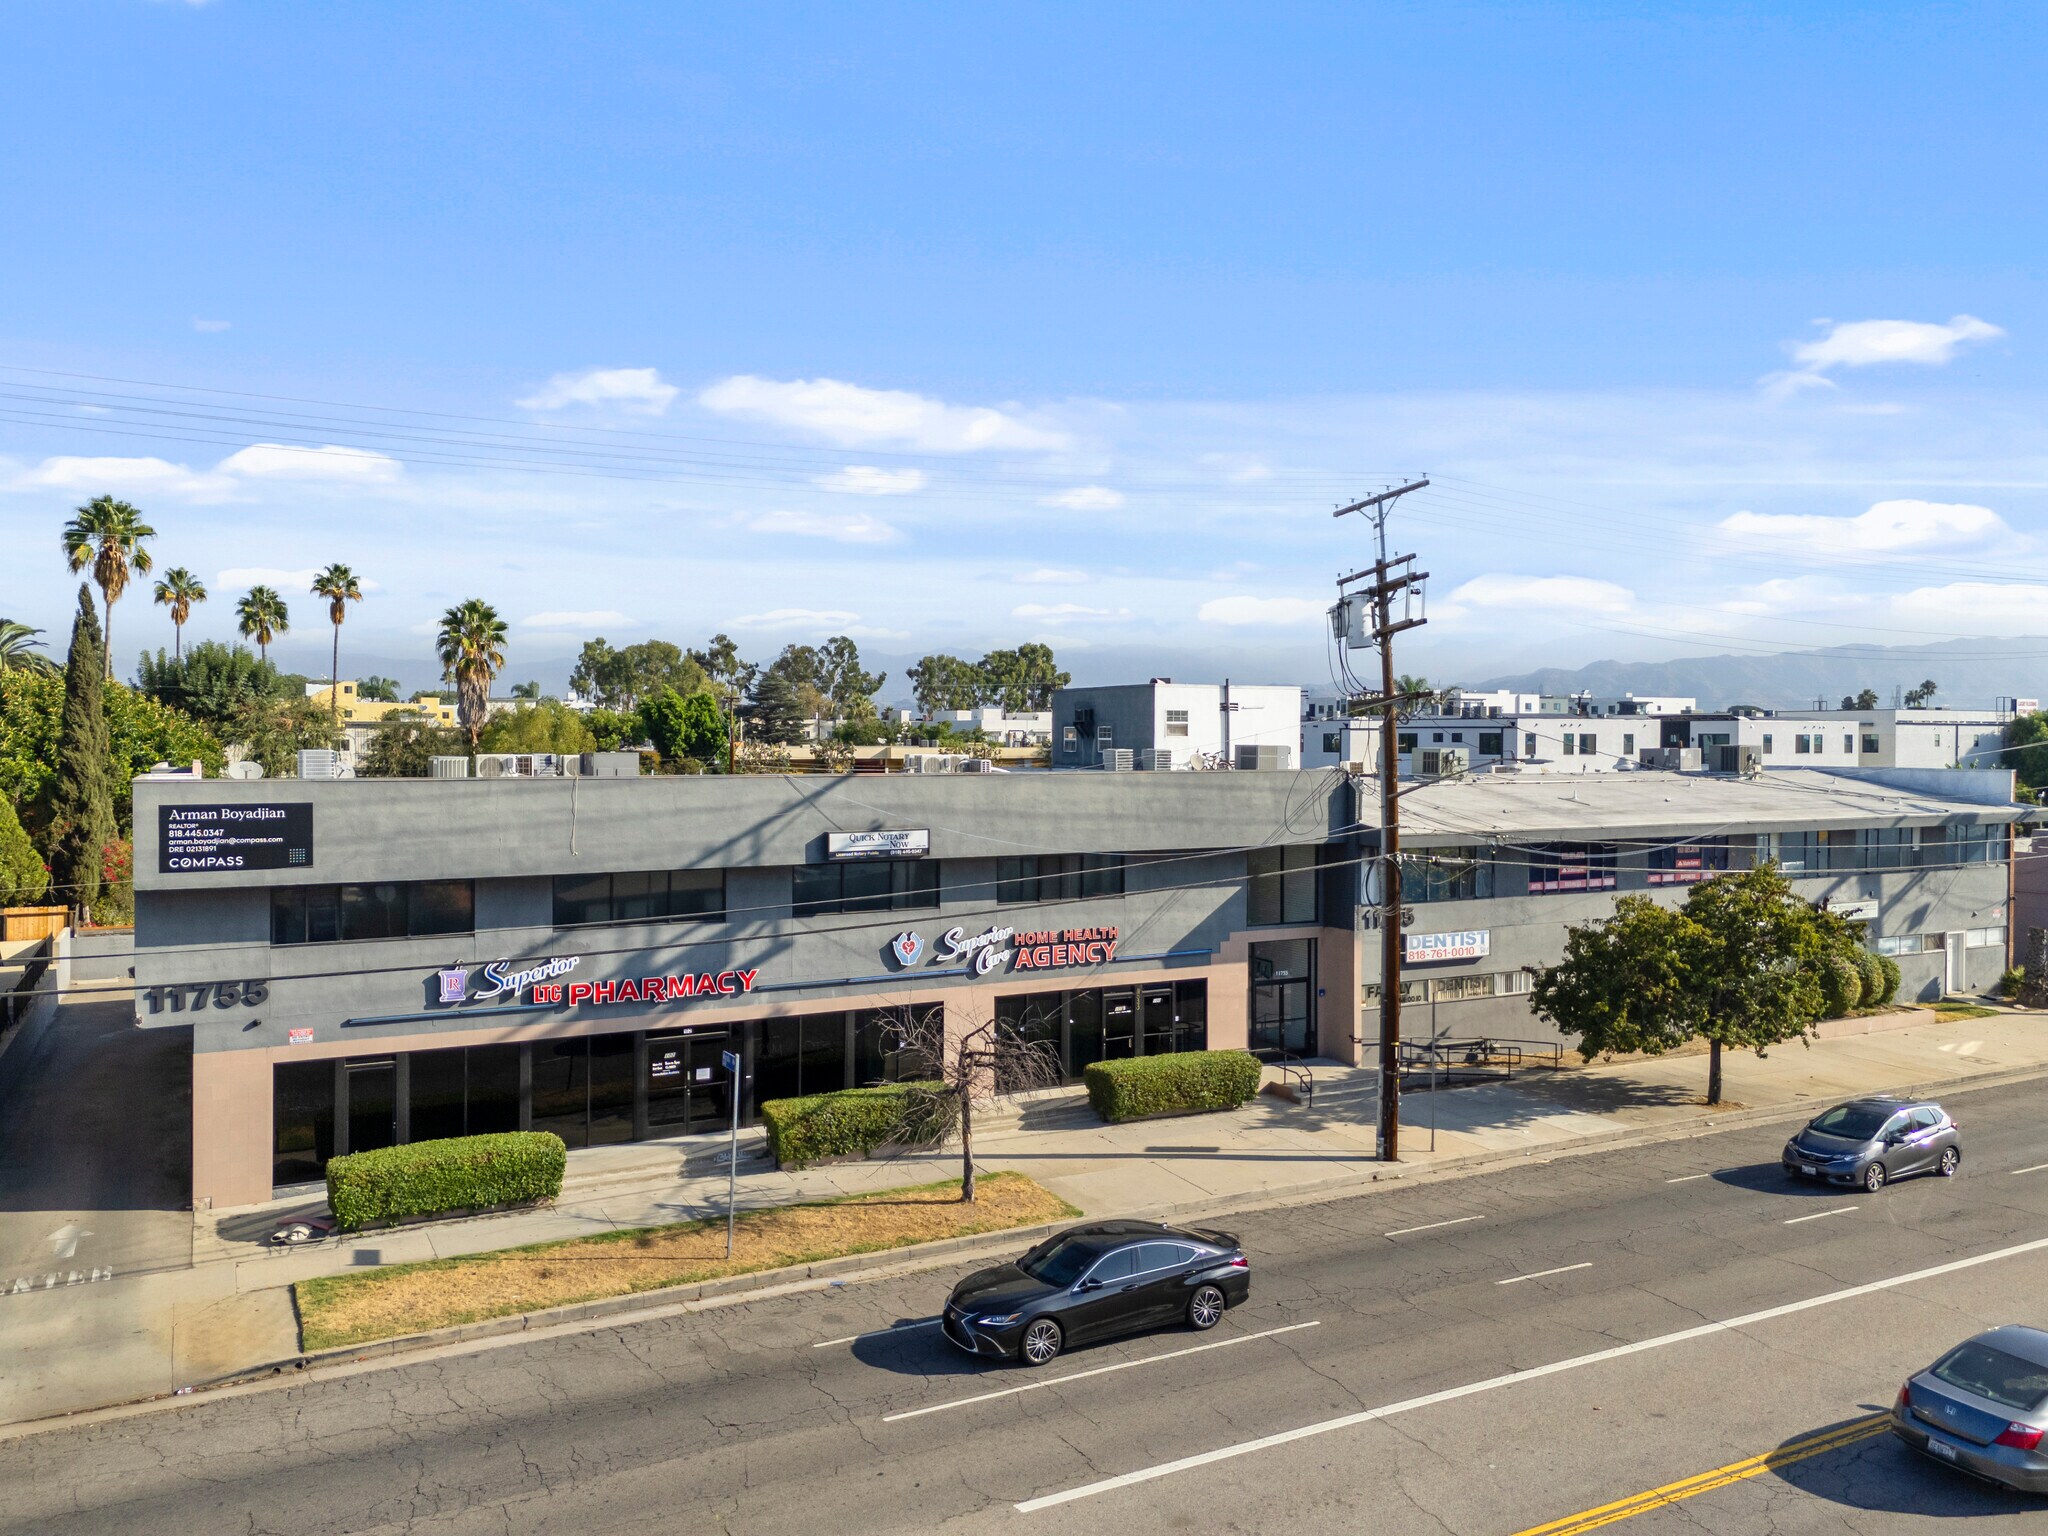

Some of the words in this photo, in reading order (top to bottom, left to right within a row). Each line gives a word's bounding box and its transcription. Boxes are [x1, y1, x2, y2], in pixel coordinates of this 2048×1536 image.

[169, 809, 217, 820] Arman
[221, 808, 286, 821] Boyadjian
[169, 829, 224, 837] 818.445.0347
[169, 836, 283, 845] arman.boyadjian@compass.com
[849, 834, 875, 843] QUICK
[877, 832, 909, 841] NOTARY
[889, 841, 909, 849] NOW
[169, 856, 244, 868] COMPASS
[936, 926, 1014, 961] Superior
[1014, 932, 1058, 946] HOME
[1063, 926, 1119, 942] HEALTH
[1408, 931, 1489, 950] DENTIST
[976, 944, 1011, 975] Care
[1015, 941, 1118, 969] AGENCY
[1408, 946, 1475, 961] 818-761-0010
[474, 957, 579, 999] Superior
[534, 984, 562, 1004] LTC
[568, 969, 760, 1007] PHARMACY
[145, 980, 269, 1014] 11755
